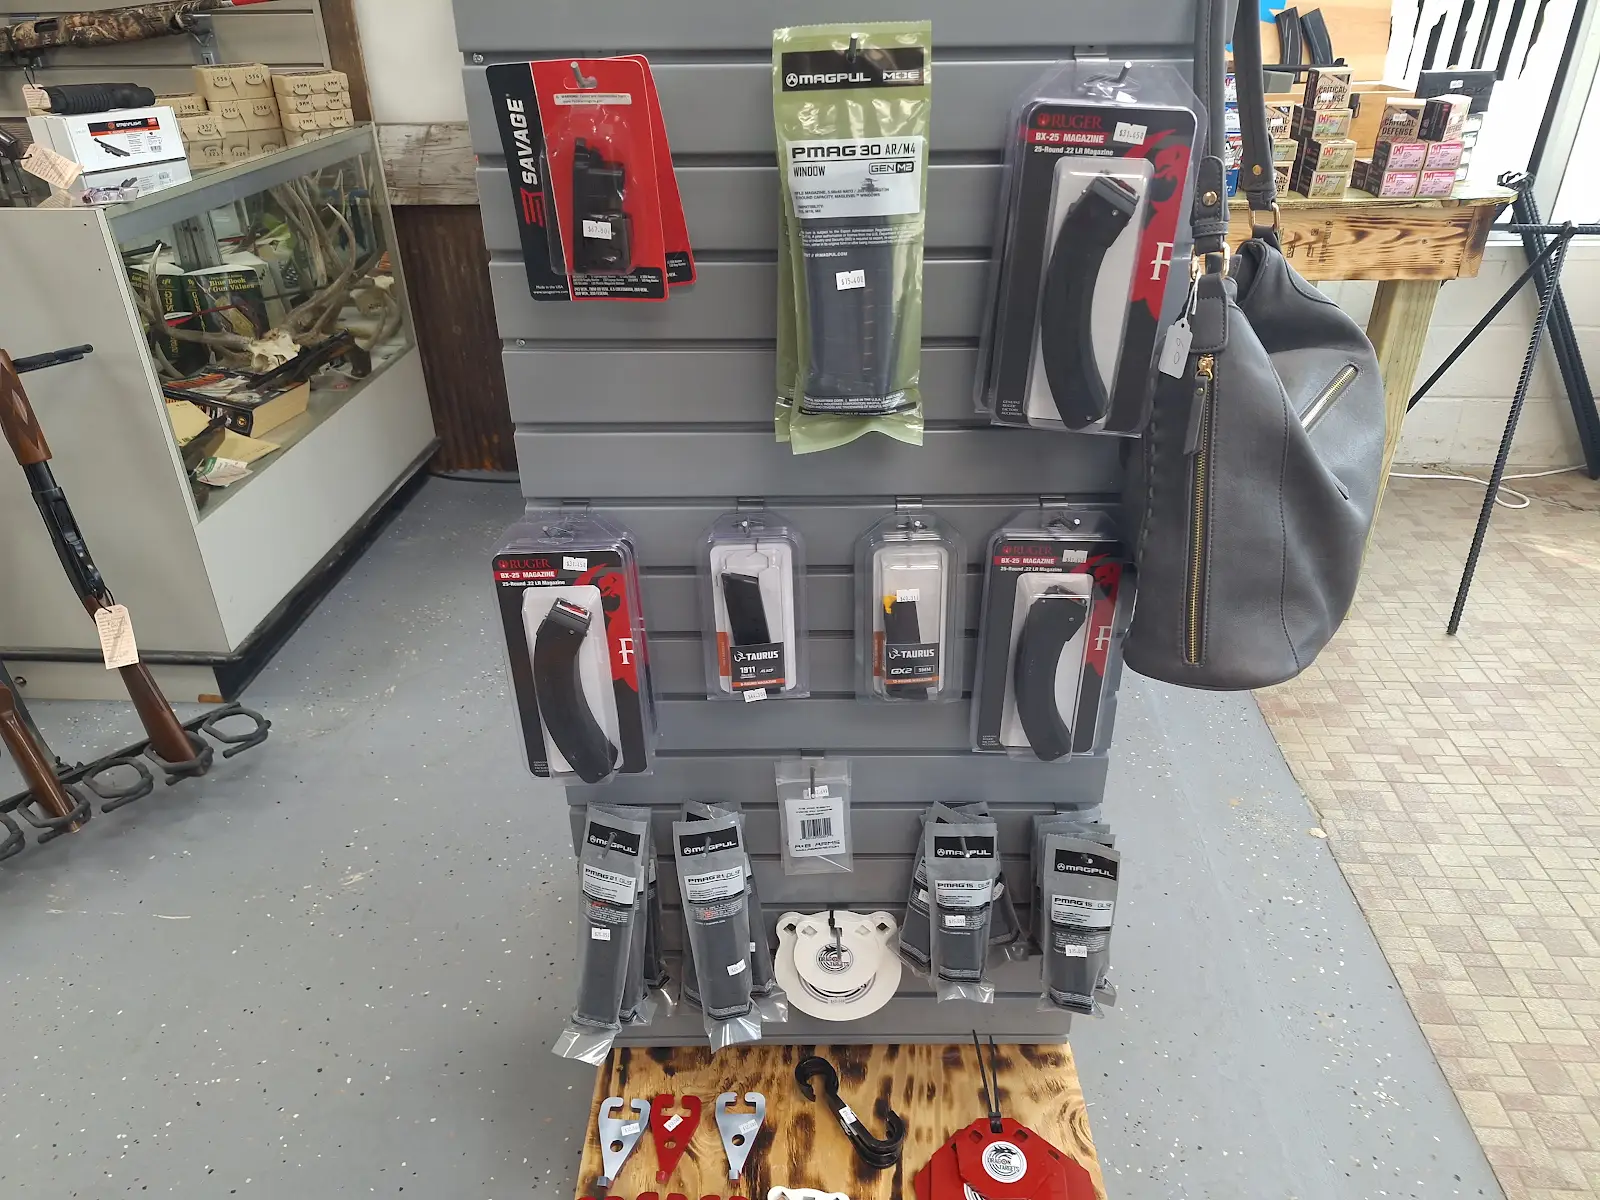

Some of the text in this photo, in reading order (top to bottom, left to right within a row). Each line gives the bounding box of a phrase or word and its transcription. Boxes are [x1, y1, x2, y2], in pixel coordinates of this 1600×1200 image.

[799, 70, 919, 84] MAGPUL MOE
[1319, 86, 1347, 95] CRITICAL
[1051, 114, 1103, 129] RUGER
[1382, 127, 1413, 136] DEFENSE
[507, 98, 538, 185] SAVAGE
[1035, 132, 1104, 144] BX-25 MAGAZINE
[791, 143, 916, 158] PMAG 30 AR/M4
[1034, 146, 1063, 154] 25-Round
[1084, 148, 1114, 157] Magazine
[793, 165, 826, 177] WINDOW
[1013, 546, 1052, 555] RUGER
[510, 559, 550, 569] RUGER
[746, 651, 779, 660] TAURUS
[901, 649, 935, 659] TAURUS
[740, 666, 756, 674] 1911
[1066, 865, 1115, 878] MAGPUL
[1054, 898, 1083, 906] PMAG
[987, 1157, 1011, 1165] DRAGON
[999, 1164, 1020, 1173] TARGETS
